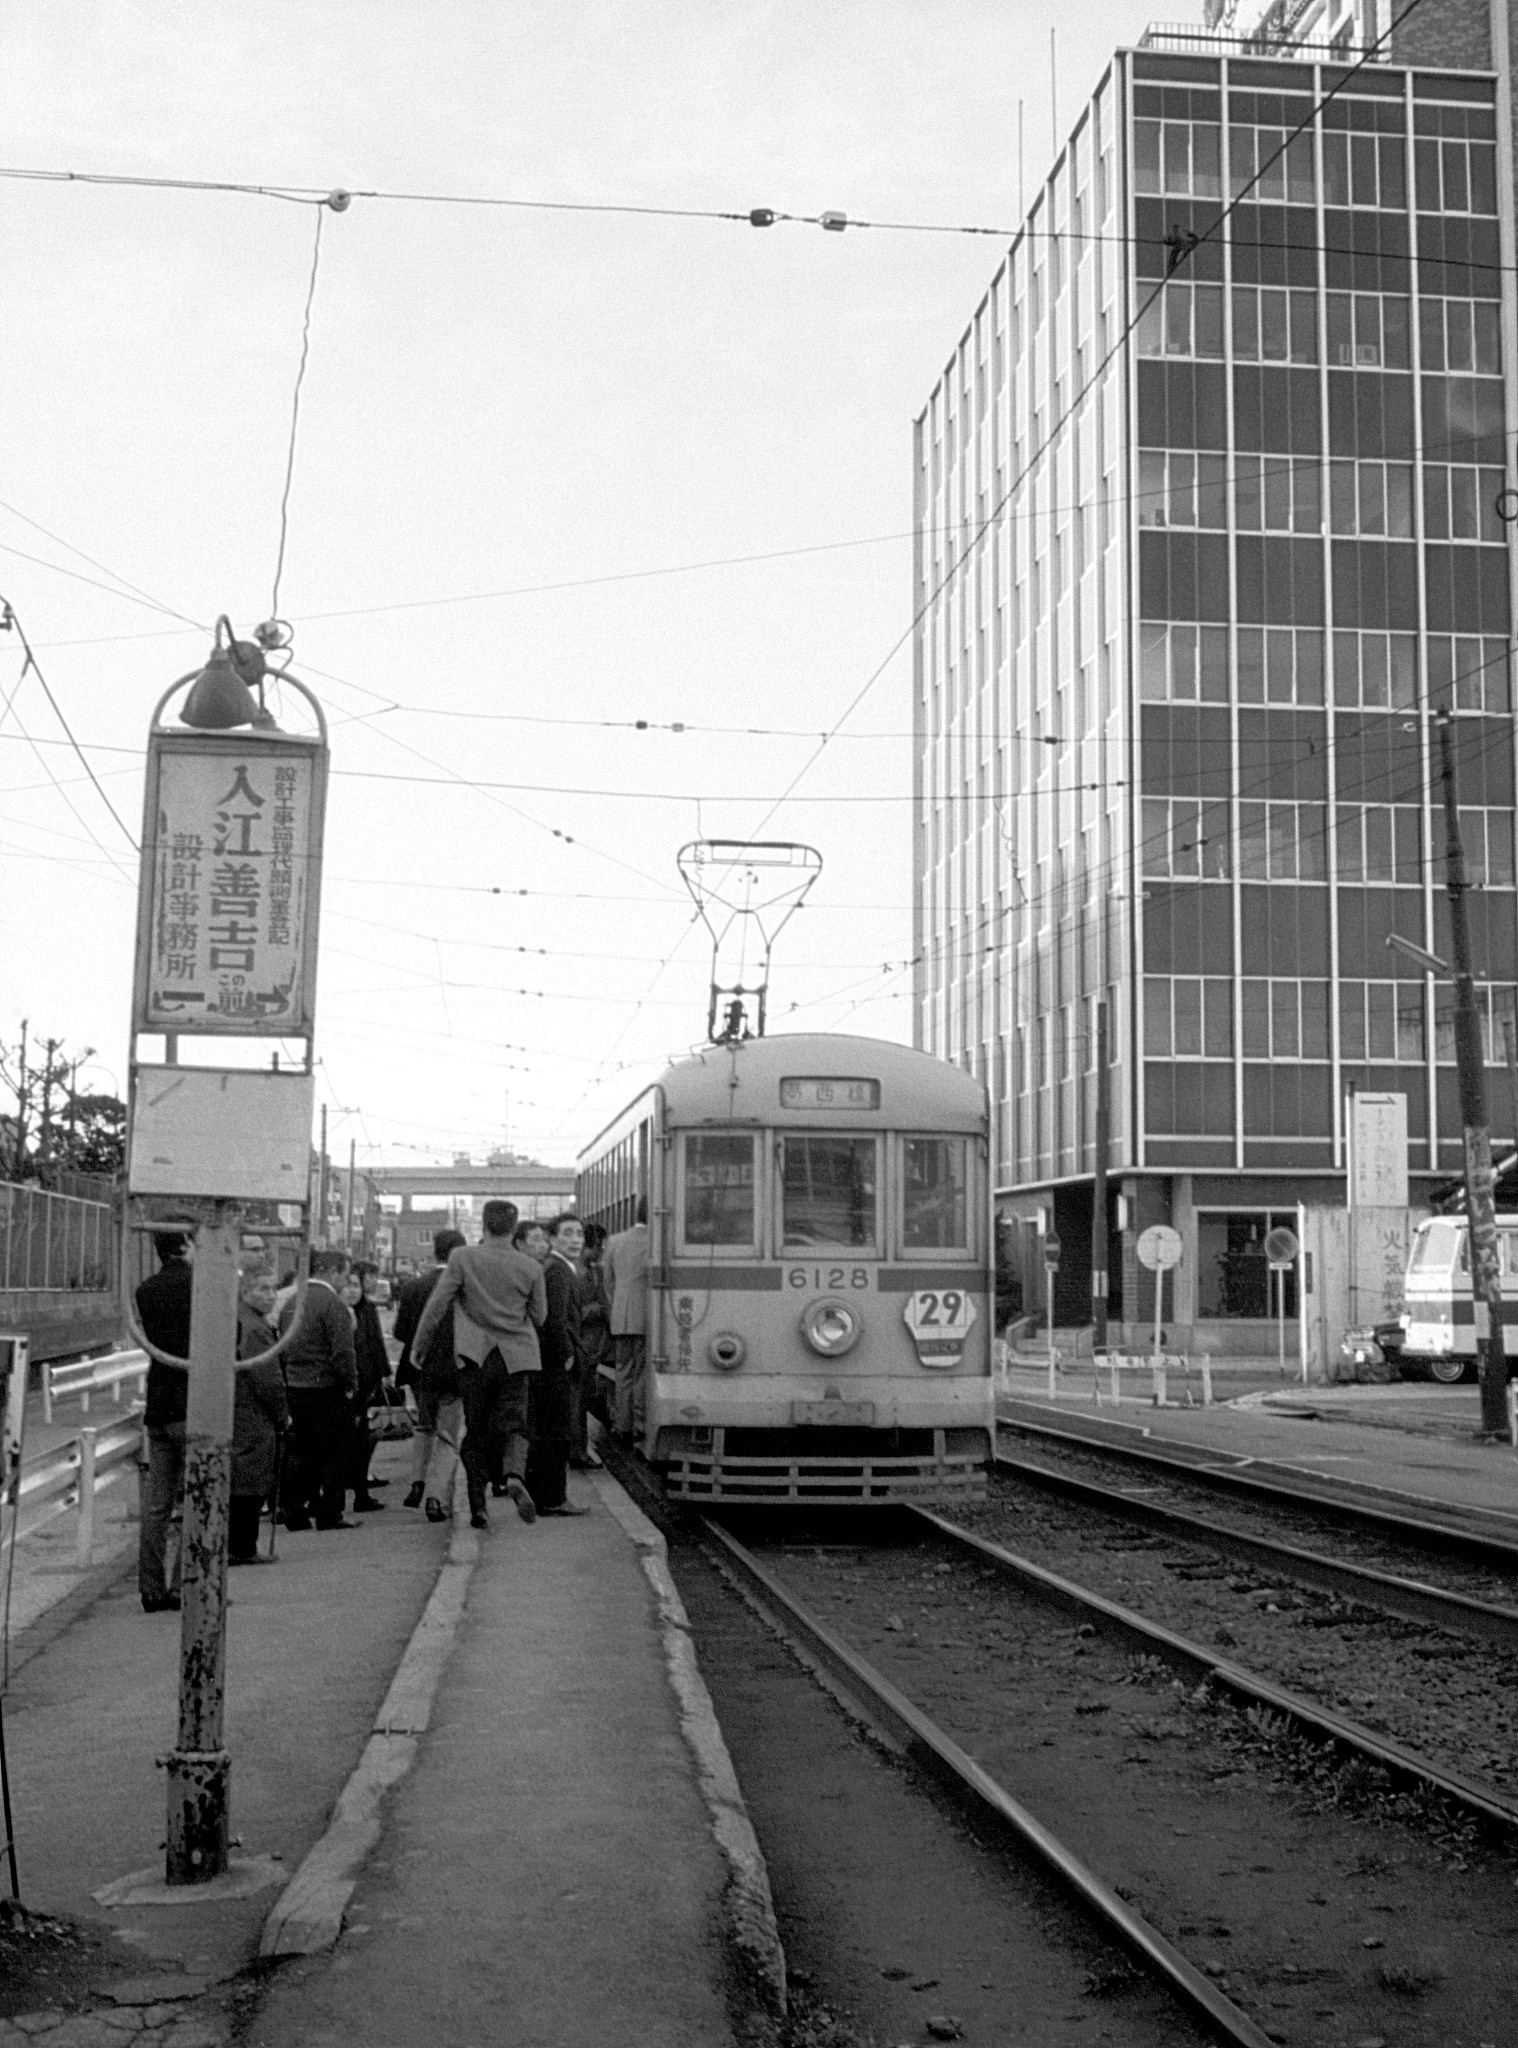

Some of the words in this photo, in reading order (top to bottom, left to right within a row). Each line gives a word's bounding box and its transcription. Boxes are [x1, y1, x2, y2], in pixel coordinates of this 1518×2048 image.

[166, 832, 203, 981] 設計事務所
[788, 1268, 869, 1290] 6128
[919, 1292, 961, 1325] 29
